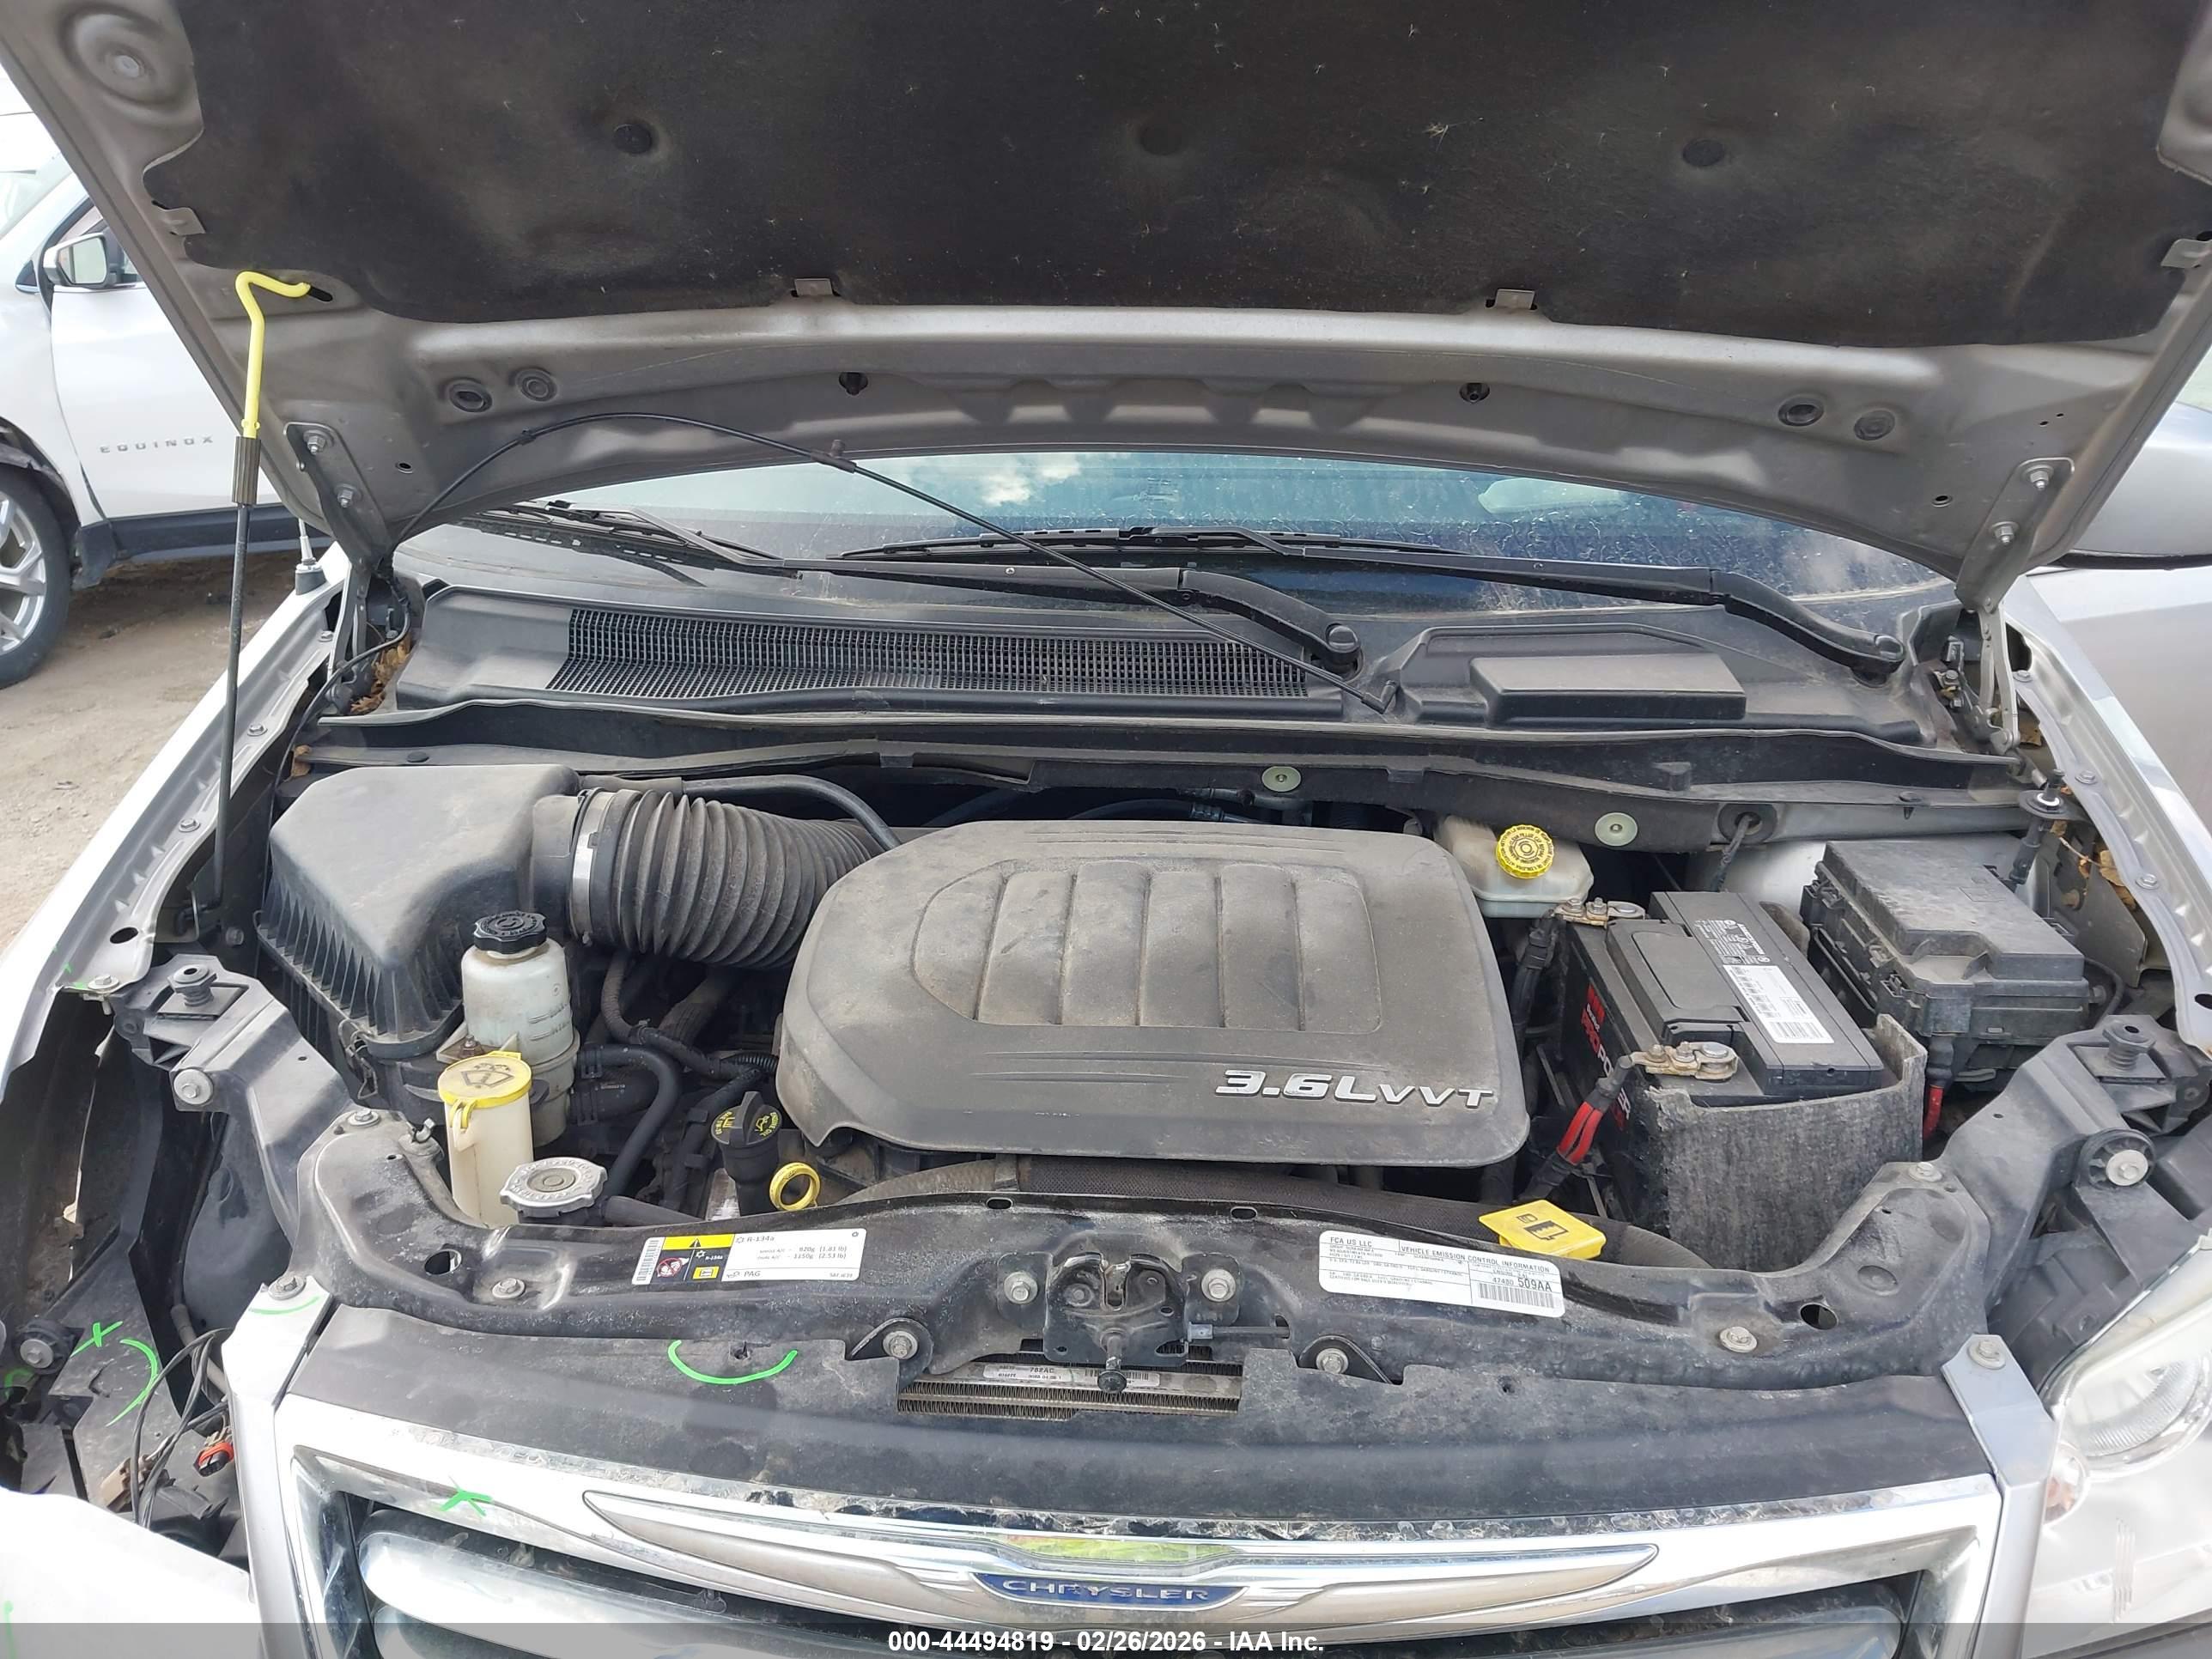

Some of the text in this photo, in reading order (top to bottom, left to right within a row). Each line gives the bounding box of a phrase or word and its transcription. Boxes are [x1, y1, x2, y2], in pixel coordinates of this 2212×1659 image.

[100, 436, 213, 453] EQUINOX
[1401, 1245, 1430, 1255] VEHICLE
[1431, 1249, 1466, 1261] EMISSION
[1468, 1255, 1499, 1266] CONTROL
[1501, 1261, 1550, 1273] INFORMATION
[1517, 1278, 1553, 1292] 509AA
[1003, 1580, 1209, 1601] CHRYSLER
